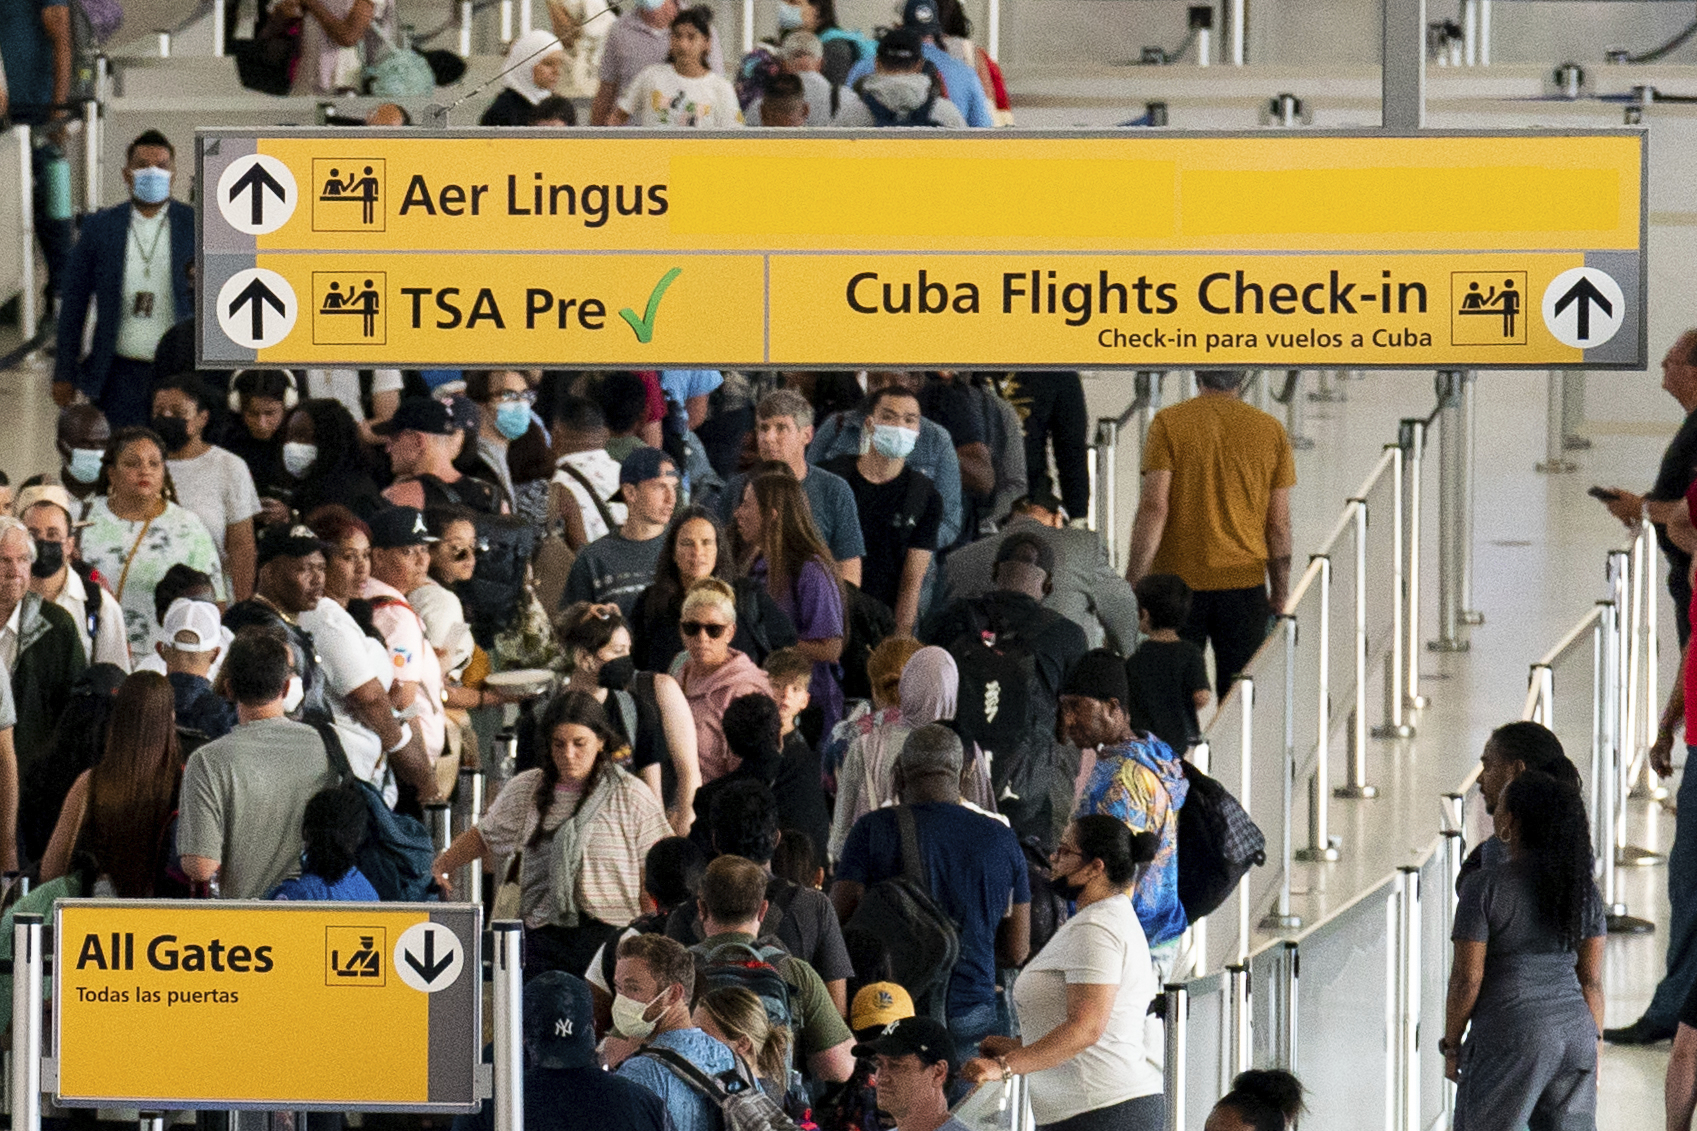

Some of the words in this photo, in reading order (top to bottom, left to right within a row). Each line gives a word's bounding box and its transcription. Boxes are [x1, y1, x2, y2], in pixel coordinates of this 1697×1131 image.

[399, 175, 488, 216] Aer
[508, 173, 668, 227] Lingus
[401, 288, 505, 329] TSA
[527, 289, 606, 329] Pre
[847, 270, 979, 313] Cuba
[1003, 270, 1177, 326] Flights
[1199, 270, 1426, 314] Check-in
[1098, 328, 1196, 347] Check-in
[1206, 334, 1257, 352] para
[1266, 328, 1342, 347] vuelos
[1351, 334, 1363, 347] a
[1373, 328, 1431, 347] Cuba
[77, 933, 133, 970] All
[147, 935, 273, 972] Gates
[76, 986, 129, 1002] Todas
[136, 987, 160, 1002] las
[168, 989, 238, 1006] puertas
